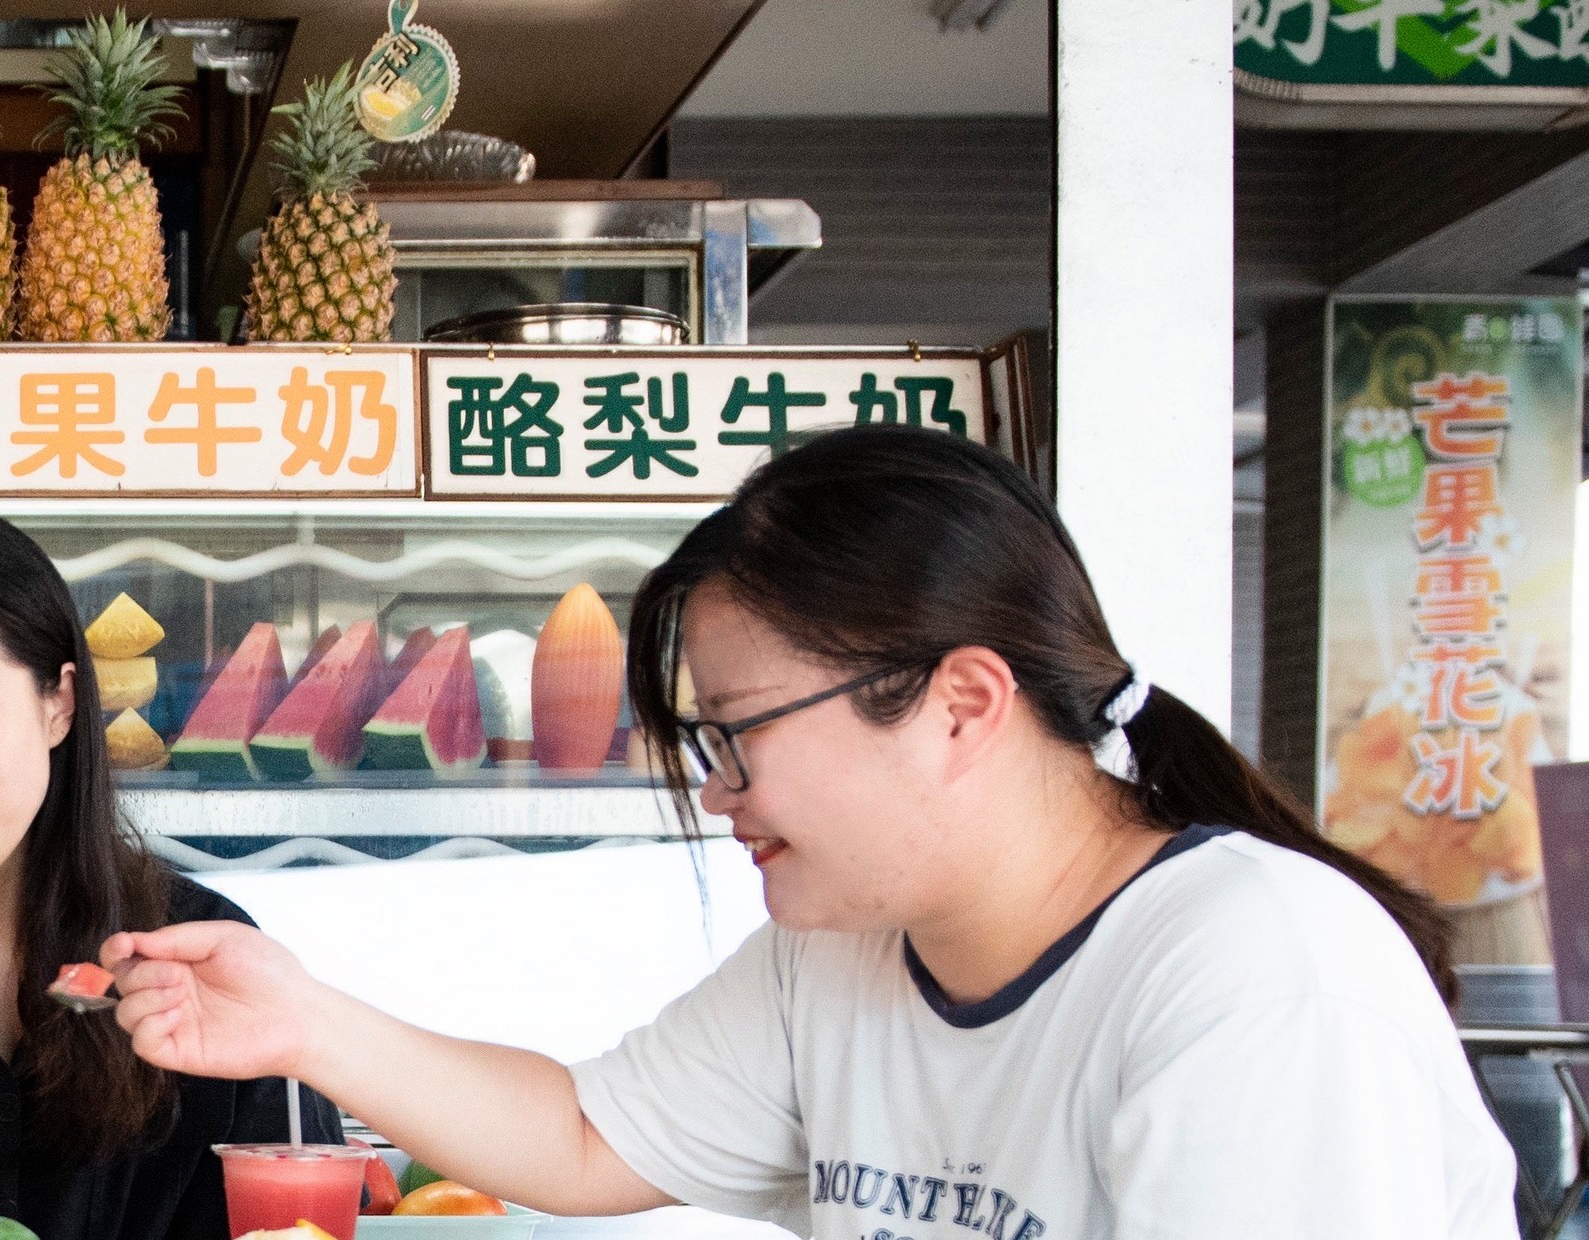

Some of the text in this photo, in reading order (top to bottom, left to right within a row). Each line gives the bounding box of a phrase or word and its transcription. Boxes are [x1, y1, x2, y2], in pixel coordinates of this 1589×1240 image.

[1405, 373, 1510, 818] 芒果雪花冰
